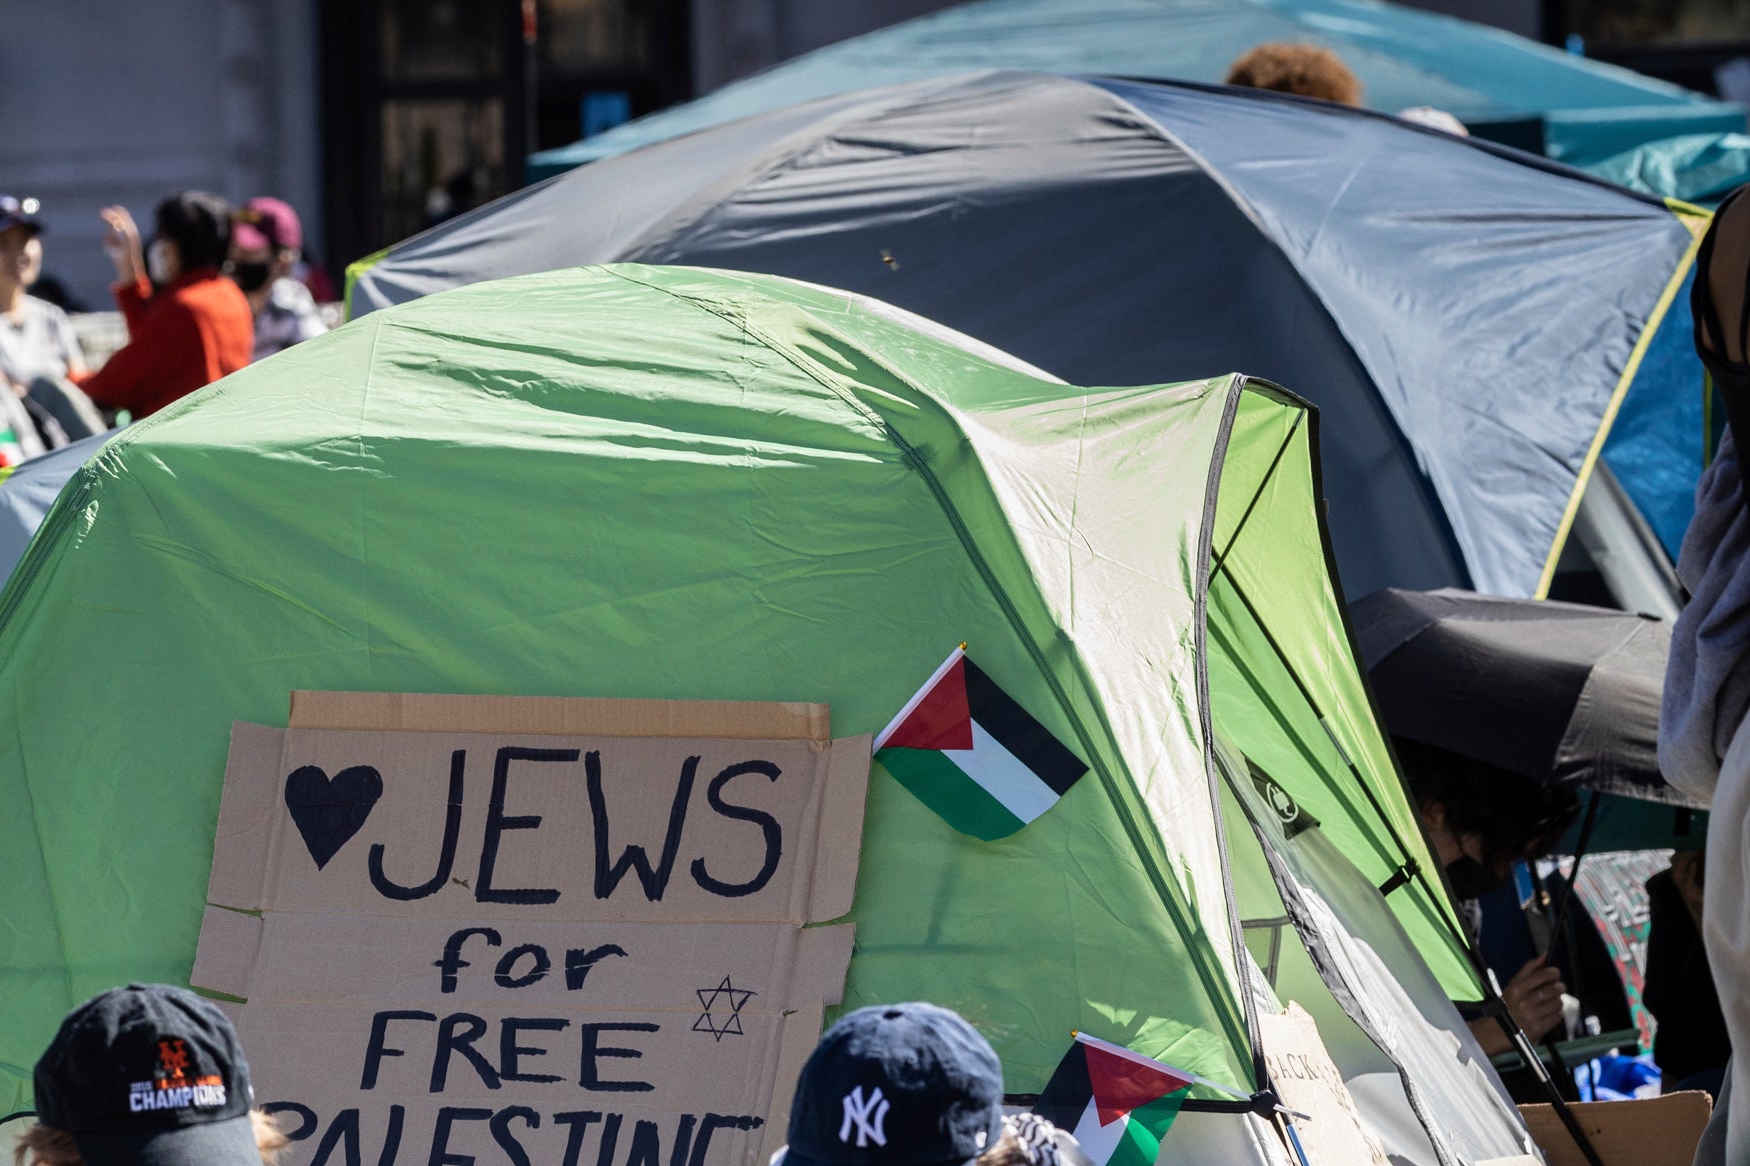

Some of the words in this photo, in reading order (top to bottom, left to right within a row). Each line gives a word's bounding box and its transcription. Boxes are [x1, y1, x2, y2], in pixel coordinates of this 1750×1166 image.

[368, 746, 783, 904] JEWS
[433, 926, 629, 994] for
[360, 1009, 661, 1093] FREE
[129, 1085, 227, 1112] CHAMPIONS
[839, 1085, 890, 1147] NY
